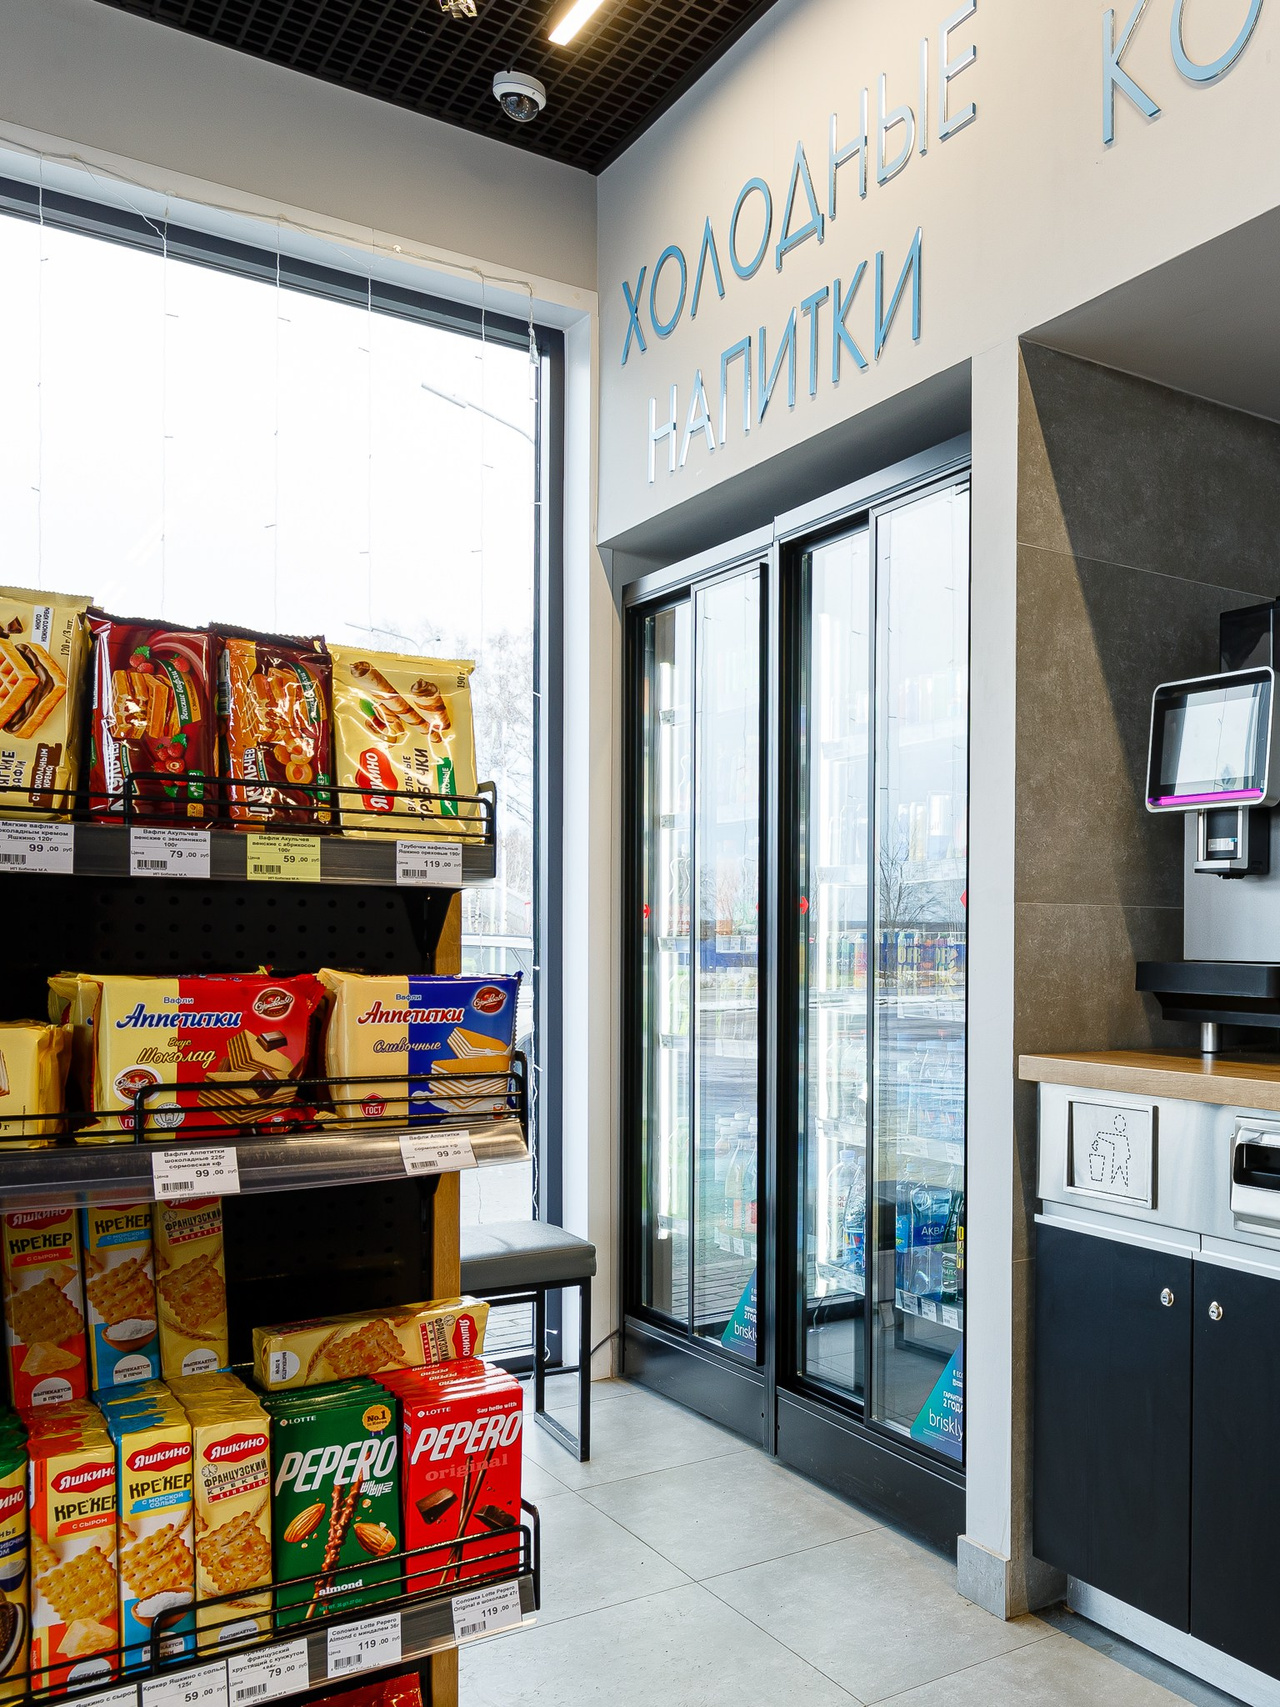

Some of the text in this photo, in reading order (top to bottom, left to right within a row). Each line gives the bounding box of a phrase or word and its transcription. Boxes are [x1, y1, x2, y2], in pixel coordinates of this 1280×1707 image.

[622, 0, 977, 366] ХОЛОДНЫЕ
[650, 226, 923, 484] НАПИТКИ
[61, 643, 69, 656] 120
[457, 676, 466, 689] 190
[1, 821, 54, 831] Мягкие вафли
[7, 834, 36, 842] Яшкино
[40, 830, 69, 838] кремом
[167, 830, 199, 838] Акульчев
[28, 844, 44, 853] 99
[170, 850, 183, 859] 79
[283, 855, 296, 863] 59
[424, 860, 440, 868] 119
[163, 997, 194, 1006] Вафли
[396, 993, 422, 1002] Вафли
[116, 1002, 243, 1029] Аппетитки
[357, 1000, 465, 1025] Аппетитки
[167, 1037, 193, 1049] Вкус
[373, 1036, 442, 1054] Сливочные
[136, 1047, 217, 1069] Шоколад
[365, 1105, 382, 1116] ГОСТ
[189, 1149, 225, 1157] Аппетитки
[437, 1150, 449, 1158] 99
[164, 1156, 209, 1164] шоколадные
[195, 1170, 210, 1178] 99
[94, 1213, 151, 1235] КРЕКЕР
[8, 1232, 73, 1255] КРЕКЕР
[33, 1253, 60, 1261] СЫРОМ
[458, 1318, 470, 1357] ЯШКИНО
[115, 1363, 151, 1375] ВЫПЕКАЕТСЯ
[183, 1358, 218, 1369] ВЫПЕКАЕТСЯ
[33, 1386, 72, 1398] ВЫПЕКАЕТСЯ
[425, 1401, 518, 1417] LOTTE Say hello with
[288, 1410, 388, 1426] LOTTE No.1
[929, 1407, 963, 1442] briskly
[411, 1410, 523, 1466] PEPERO
[210, 1436, 265, 1461] ЯШКИНО
[134, 1446, 191, 1469] ЯШКИНО
[275, 1434, 397, 1498] PEPERO
[425, 1452, 509, 1483] original
[204, 1457, 268, 1489] ФРАНЦУЗСКИЙ
[129, 1472, 193, 1499] КРЕКЕР
[207, 1471, 269, 1496] КРЕКЕР
[149, 1491, 184, 1505] МОРСКОЙ
[150, 1498, 177, 1509] СОЛЬЮ
[80, 1517, 108, 1528] СЫРОМ
[317, 1578, 364, 1597] almond
[456, 1585, 515, 1606] Соломка Lotte Pepero
[453, 1601, 475, 1613] Original
[481, 1606, 498, 1618] 119
[331, 1617, 397, 1636] Соломка Lotte Pepero
[329, 1626, 389, 1643] Almond миндалем
[358, 1640, 377, 1651] 119
[232, 1650, 305, 1673] хрустящий кунжутом
[142, 1665, 226, 1692] Крекер Яшкино солью
[267, 1667, 282, 1679] 79
[178, 1680, 192, 1690] 125г
[111, 1689, 137, 1701] сыром
[185, 1690, 200, 1703] 59
